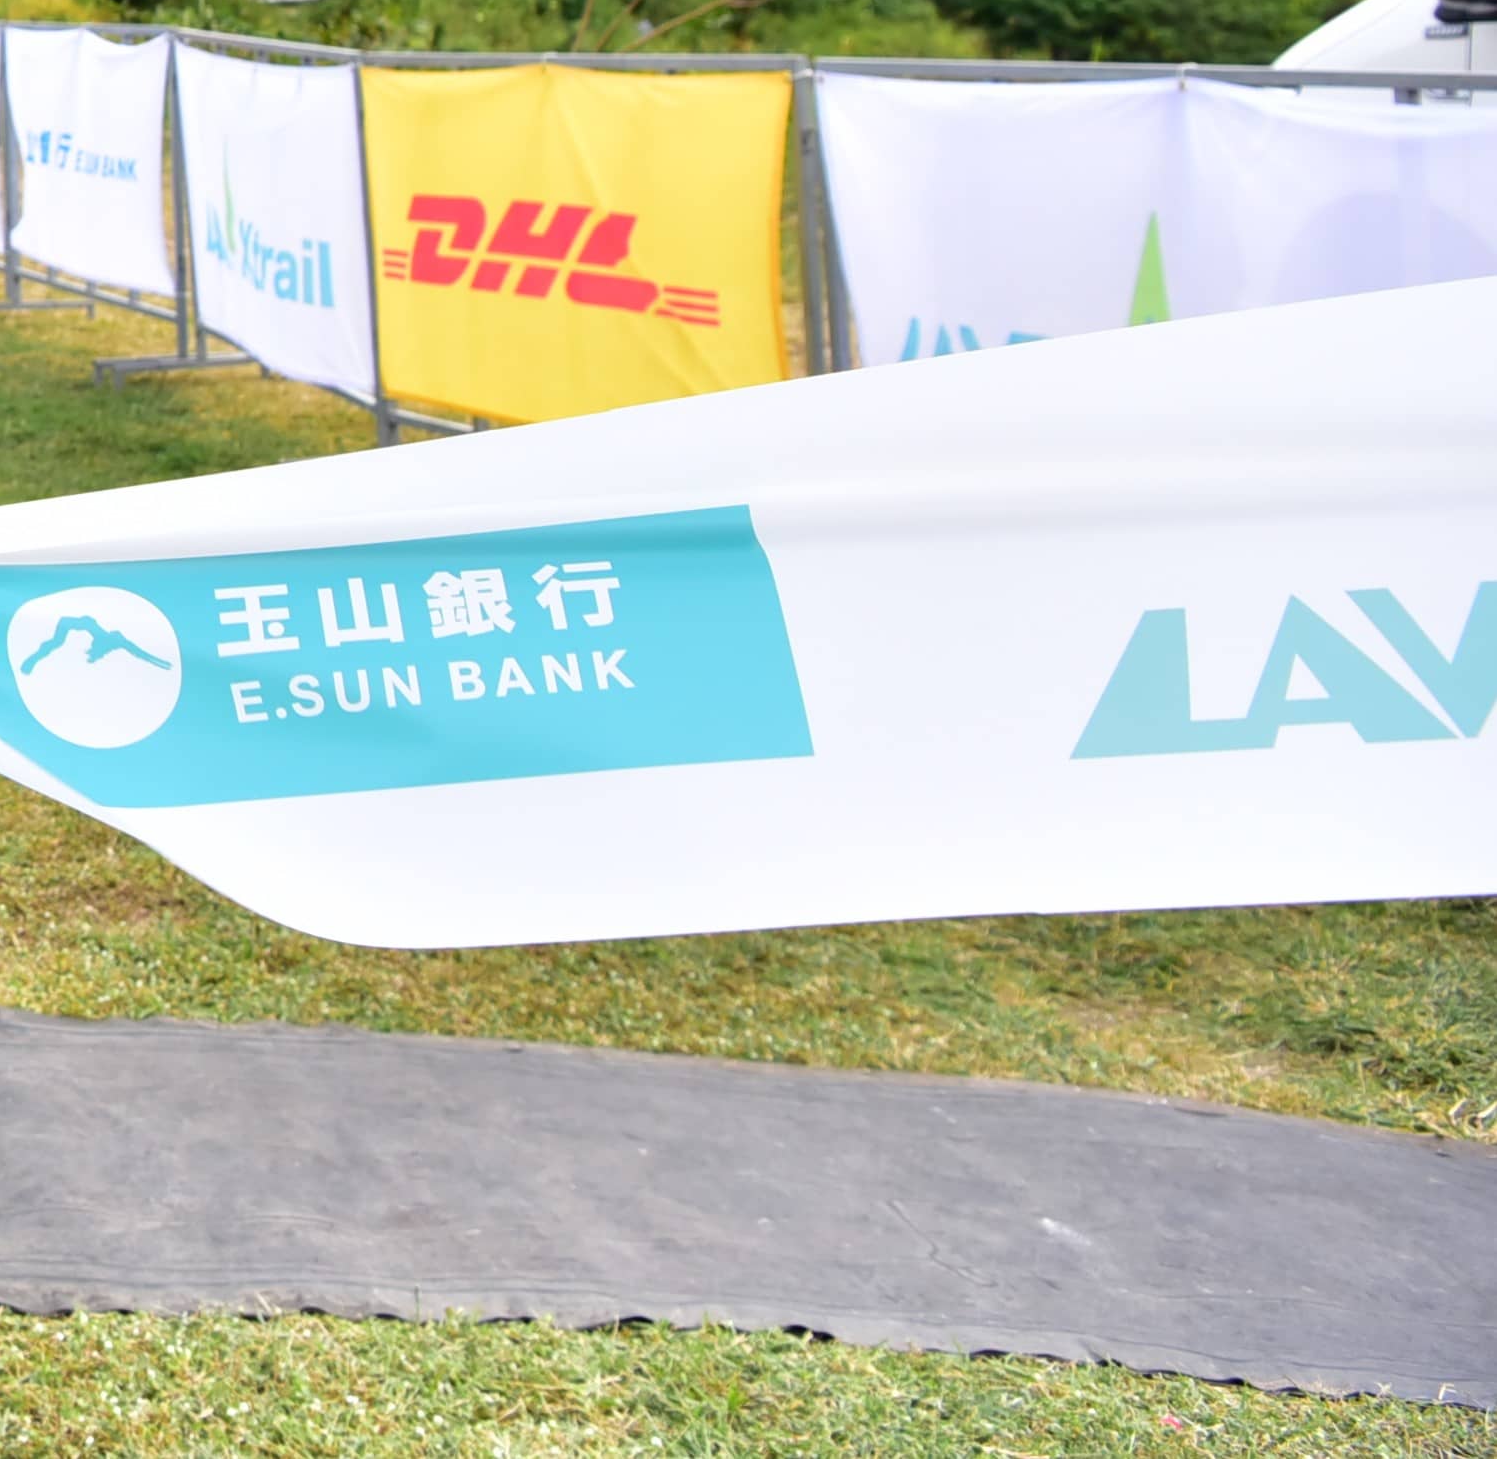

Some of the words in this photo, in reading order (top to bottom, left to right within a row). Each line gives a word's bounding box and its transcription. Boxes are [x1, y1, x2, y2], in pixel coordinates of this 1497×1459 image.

[239, 218, 334, 308] Xtrail
[407, 194, 659, 313] DHL
[215, 561, 621, 658] 玉山銀行
[229, 665, 422, 724] E.SUN
[452, 649, 636, 702] BANK
